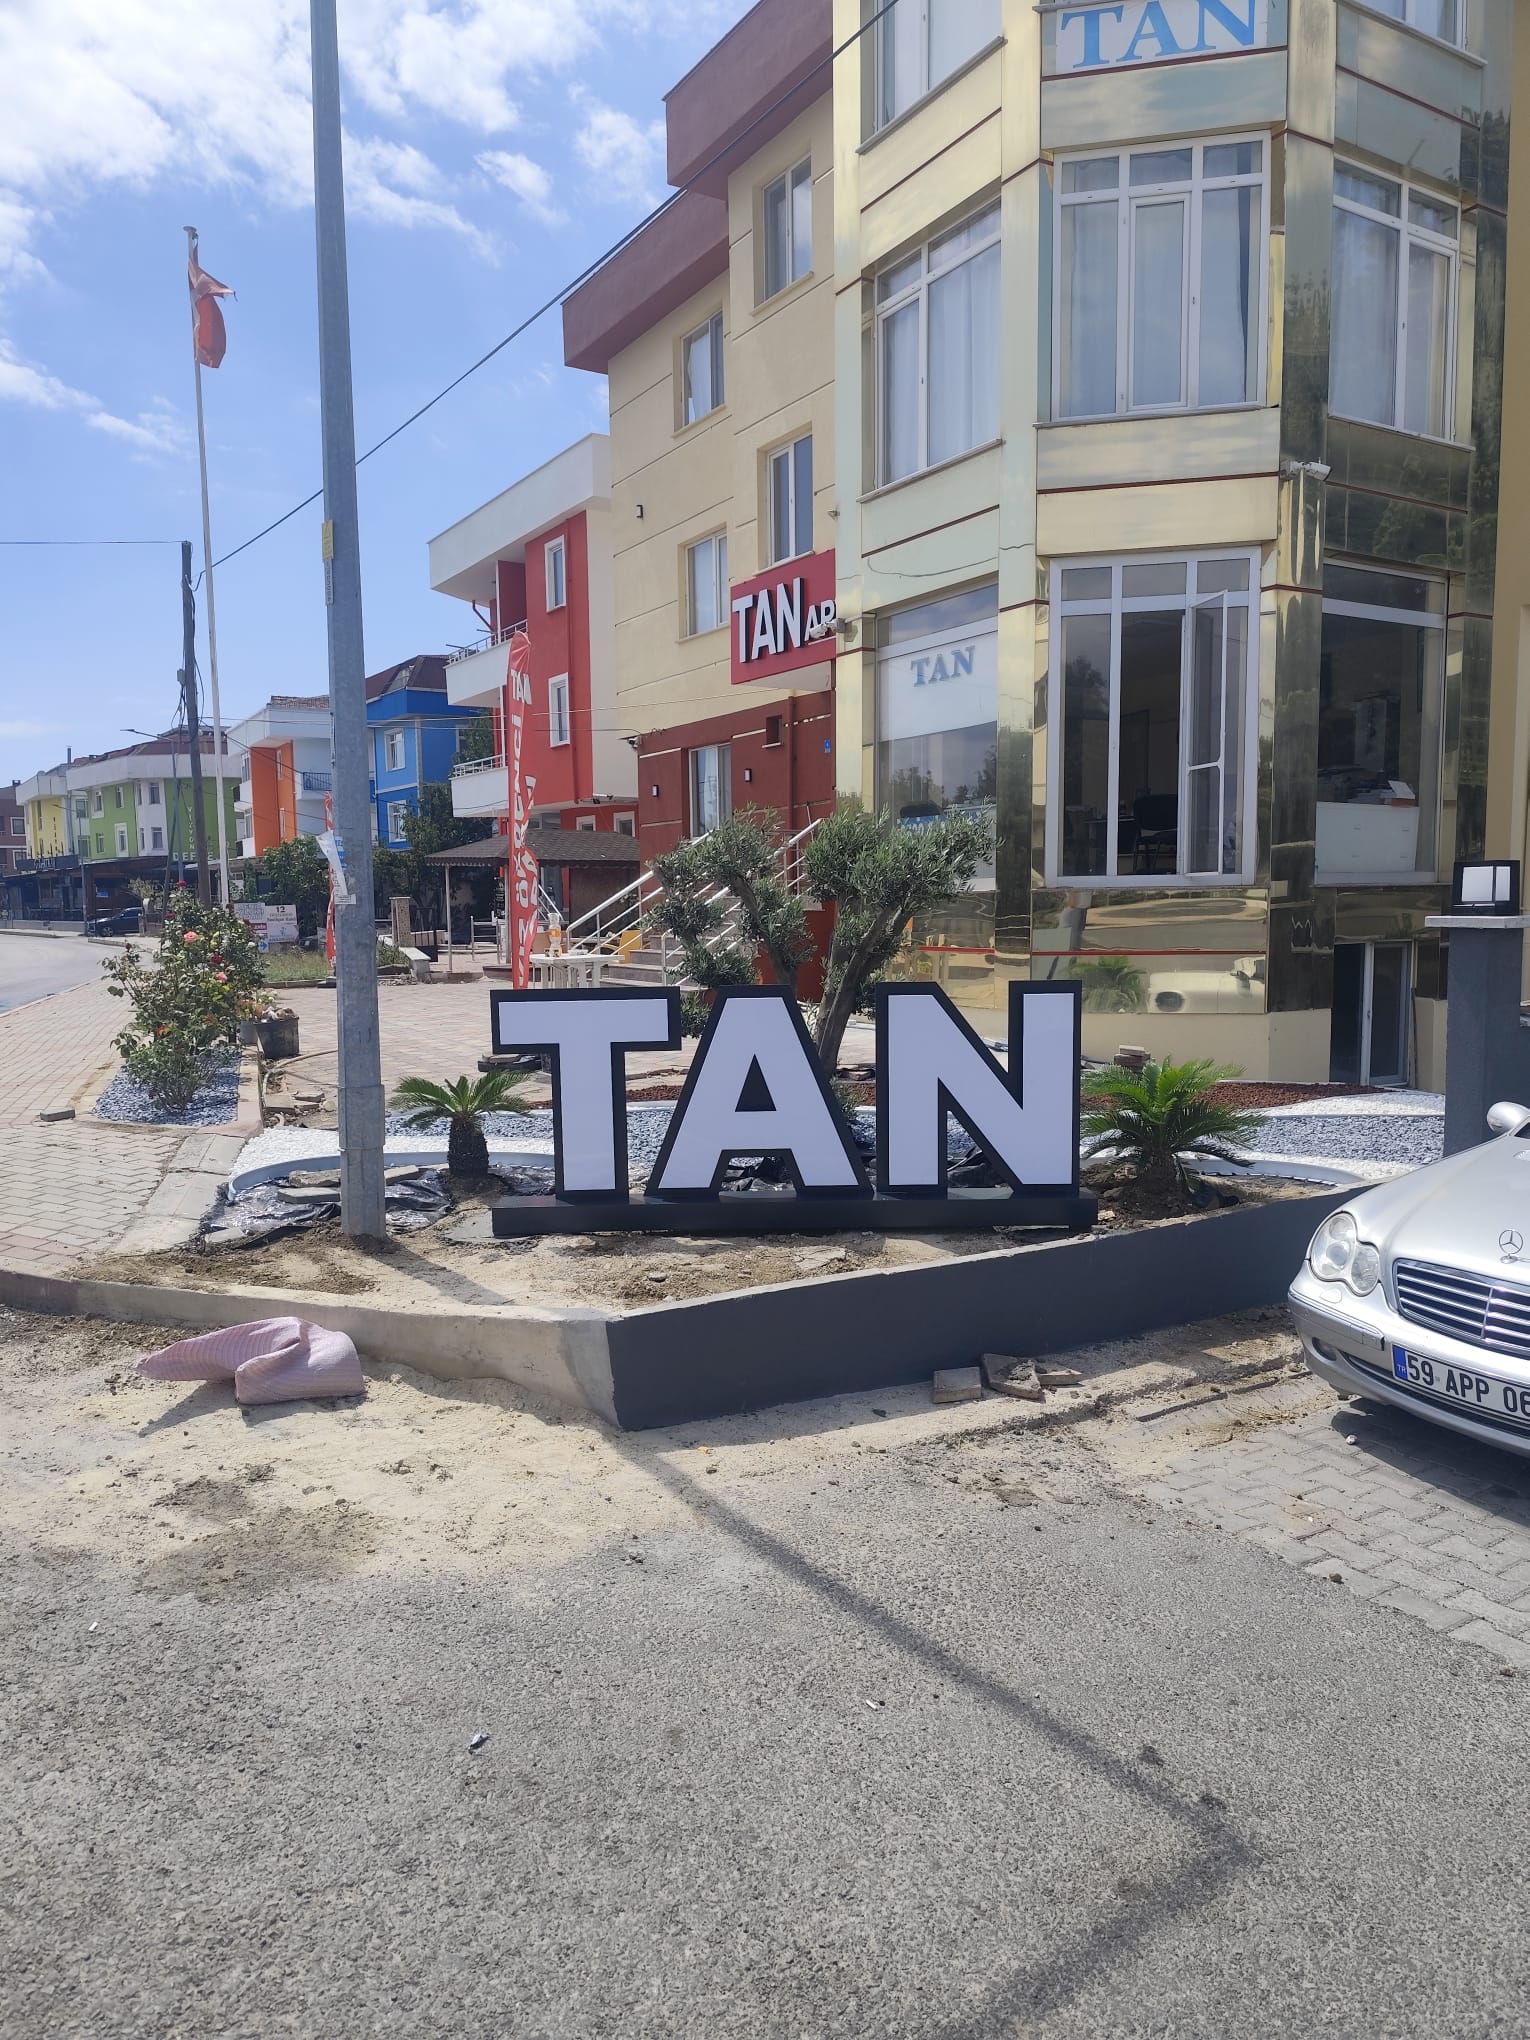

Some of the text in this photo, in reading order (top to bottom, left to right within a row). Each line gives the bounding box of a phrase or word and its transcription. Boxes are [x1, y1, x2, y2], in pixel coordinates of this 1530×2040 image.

[1060, 0, 1256, 69] TAN
[732, 577, 803, 663] TAN
[910, 645, 976, 687] TAN
[172, 851, 214, 861] DEFE
[490, 980, 1082, 1203] TAN
[1397, 1364, 1407, 1374] TR
[1407, 1355, 1434, 1386] 59
[1445, 1369, 1489, 1403] APP
